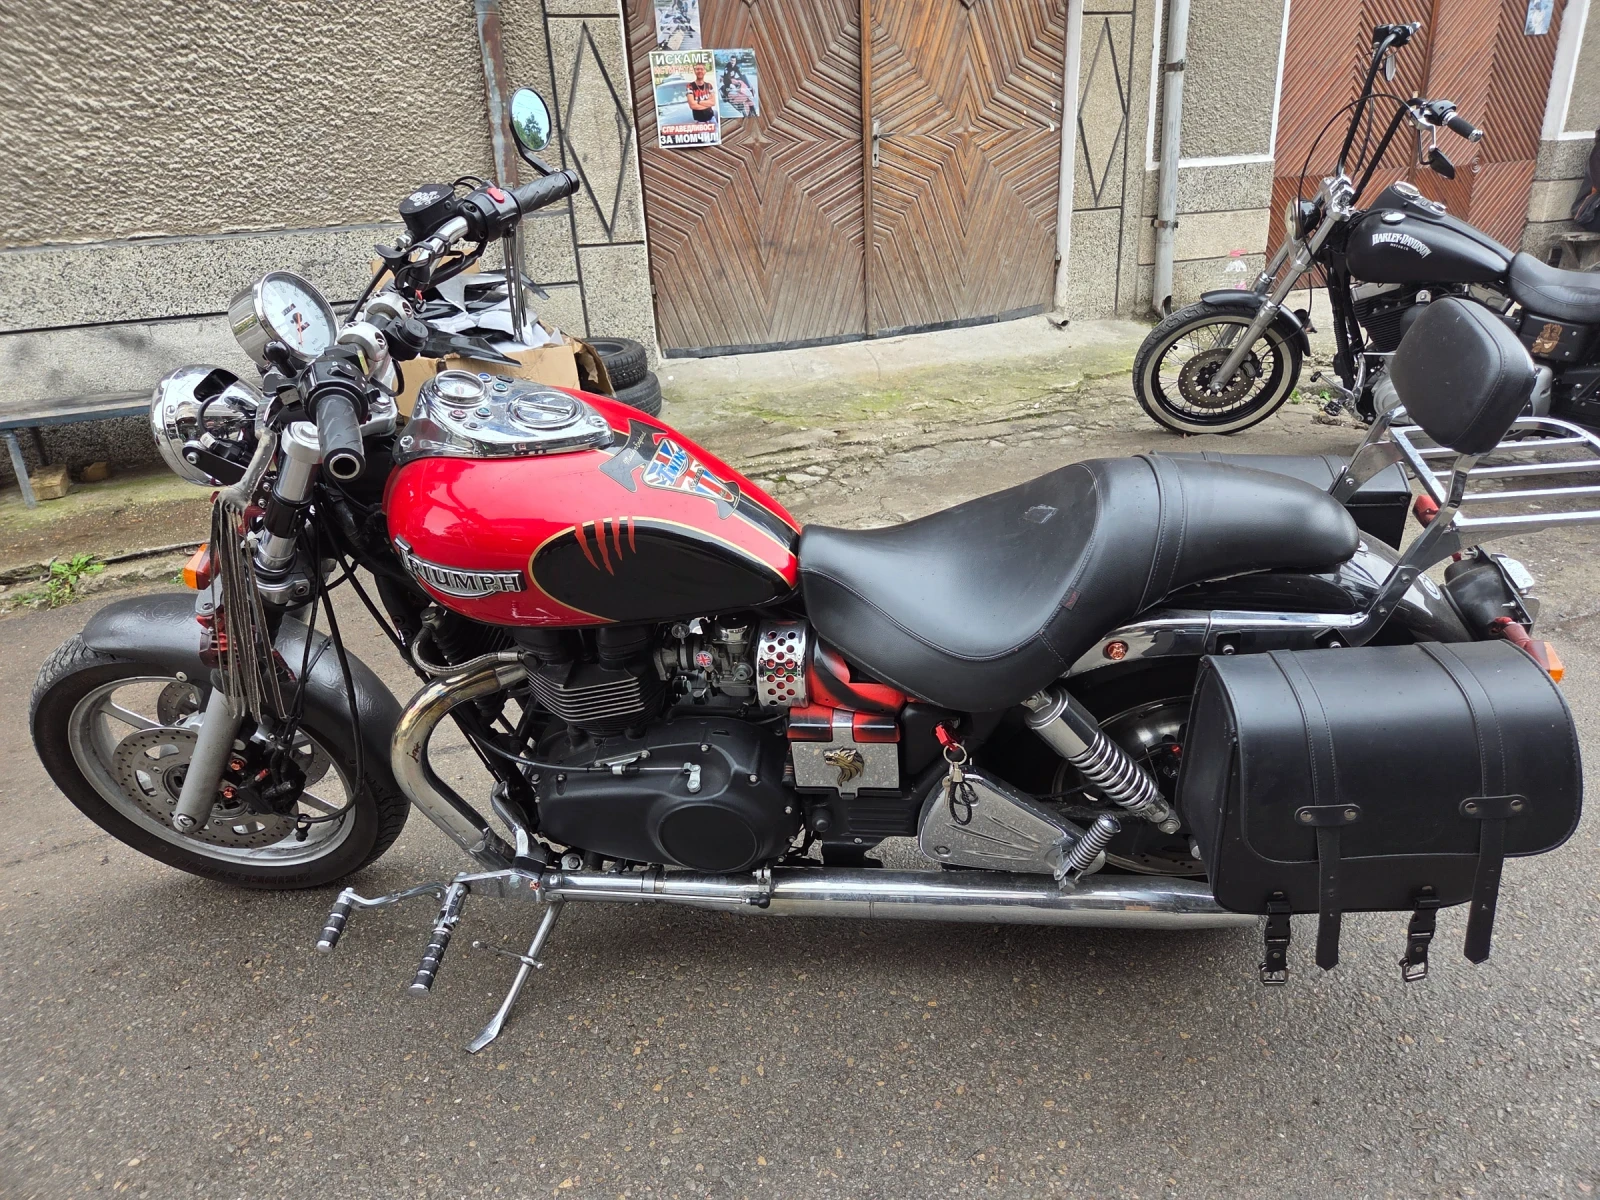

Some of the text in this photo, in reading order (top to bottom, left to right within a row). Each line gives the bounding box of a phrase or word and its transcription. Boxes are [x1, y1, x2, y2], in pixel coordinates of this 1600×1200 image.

[662, 123, 716, 134] СПРАВЕДЛИВОСТ
[660, 135, 674, 145] ЗА
[394, 535, 522, 593] TRIUMPH
